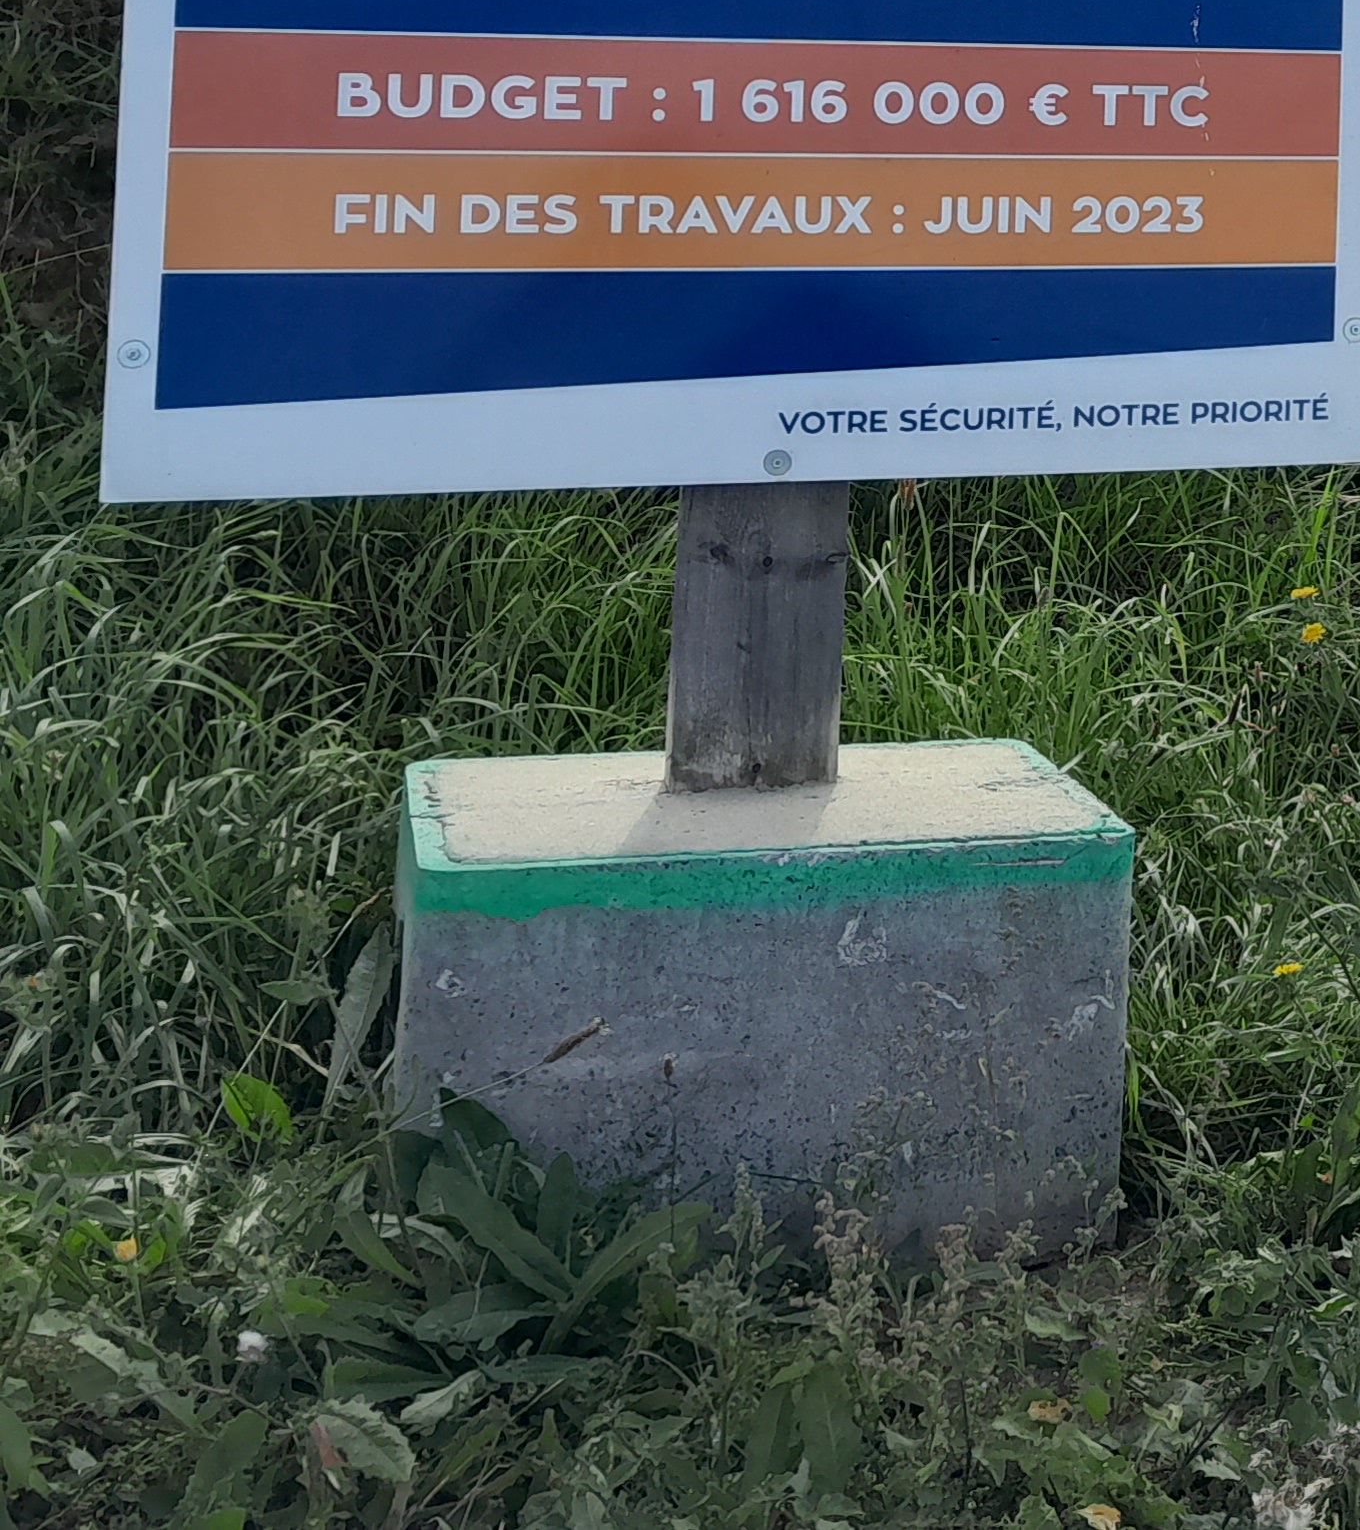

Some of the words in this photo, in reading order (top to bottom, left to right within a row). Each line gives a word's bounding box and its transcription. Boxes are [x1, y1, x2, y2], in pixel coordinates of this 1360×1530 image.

[335, 72, 627, 122] BUDGET
[693, 79, 714, 123] 1
[740, 79, 848, 125] 616
[873, 80, 1004, 126] 000
[1028, 83, 1068, 127] €
[1092, 83, 1209, 128] TTC
[333, 193, 437, 235] FIN
[459, 193, 578, 235] DES
[600, 194, 873, 236] TRAVAUX
[923, 195, 1053, 235] JUIN
[1072, 195, 1204, 235] 2023
[778, 408, 888, 435] VOTRE
[897, 401, 1063, 433] SÉCURITÉ,
[1073, 403, 1180, 429] NOTRE
[1190, 392, 1330, 425] PRIORITÉ
